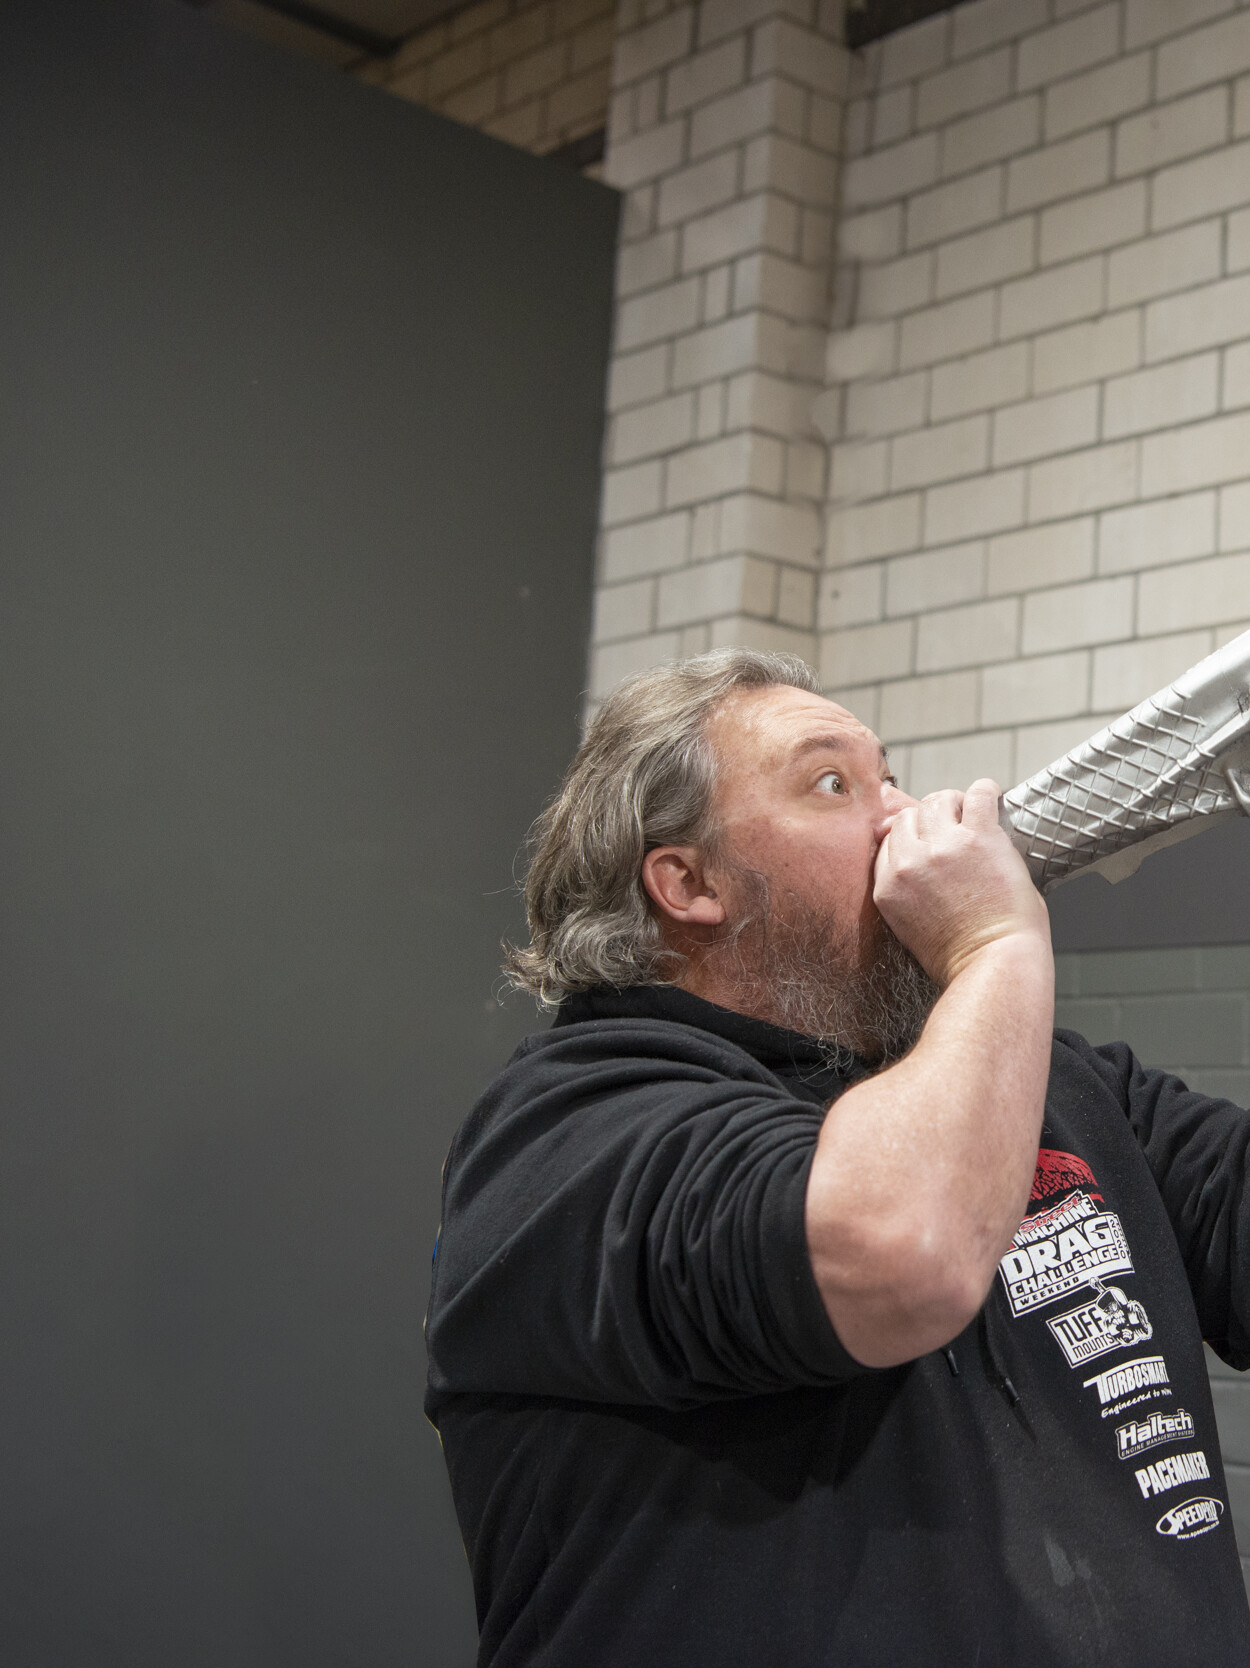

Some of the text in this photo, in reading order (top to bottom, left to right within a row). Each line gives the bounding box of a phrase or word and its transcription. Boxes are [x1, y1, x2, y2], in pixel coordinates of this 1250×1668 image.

[1013, 1198, 1097, 1246] MACHINE
[1019, 1196, 1081, 1234] Street
[1001, 1216, 1116, 1286] DRAG
[1109, 1218, 1127, 1260] 2020
[1009, 1244, 1121, 1300] CHALLENGE
[1020, 1276, 1080, 1306] WEEKEND
[1053, 1306, 1104, 1347] TUFF
[1101, 1391, 1152, 1419] Engineered
[1119, 1411, 1192, 1450] Haltech
[1121, 1443, 1145, 1457] ENGINE
[1134, 1451, 1211, 1499] PACEMAKER
